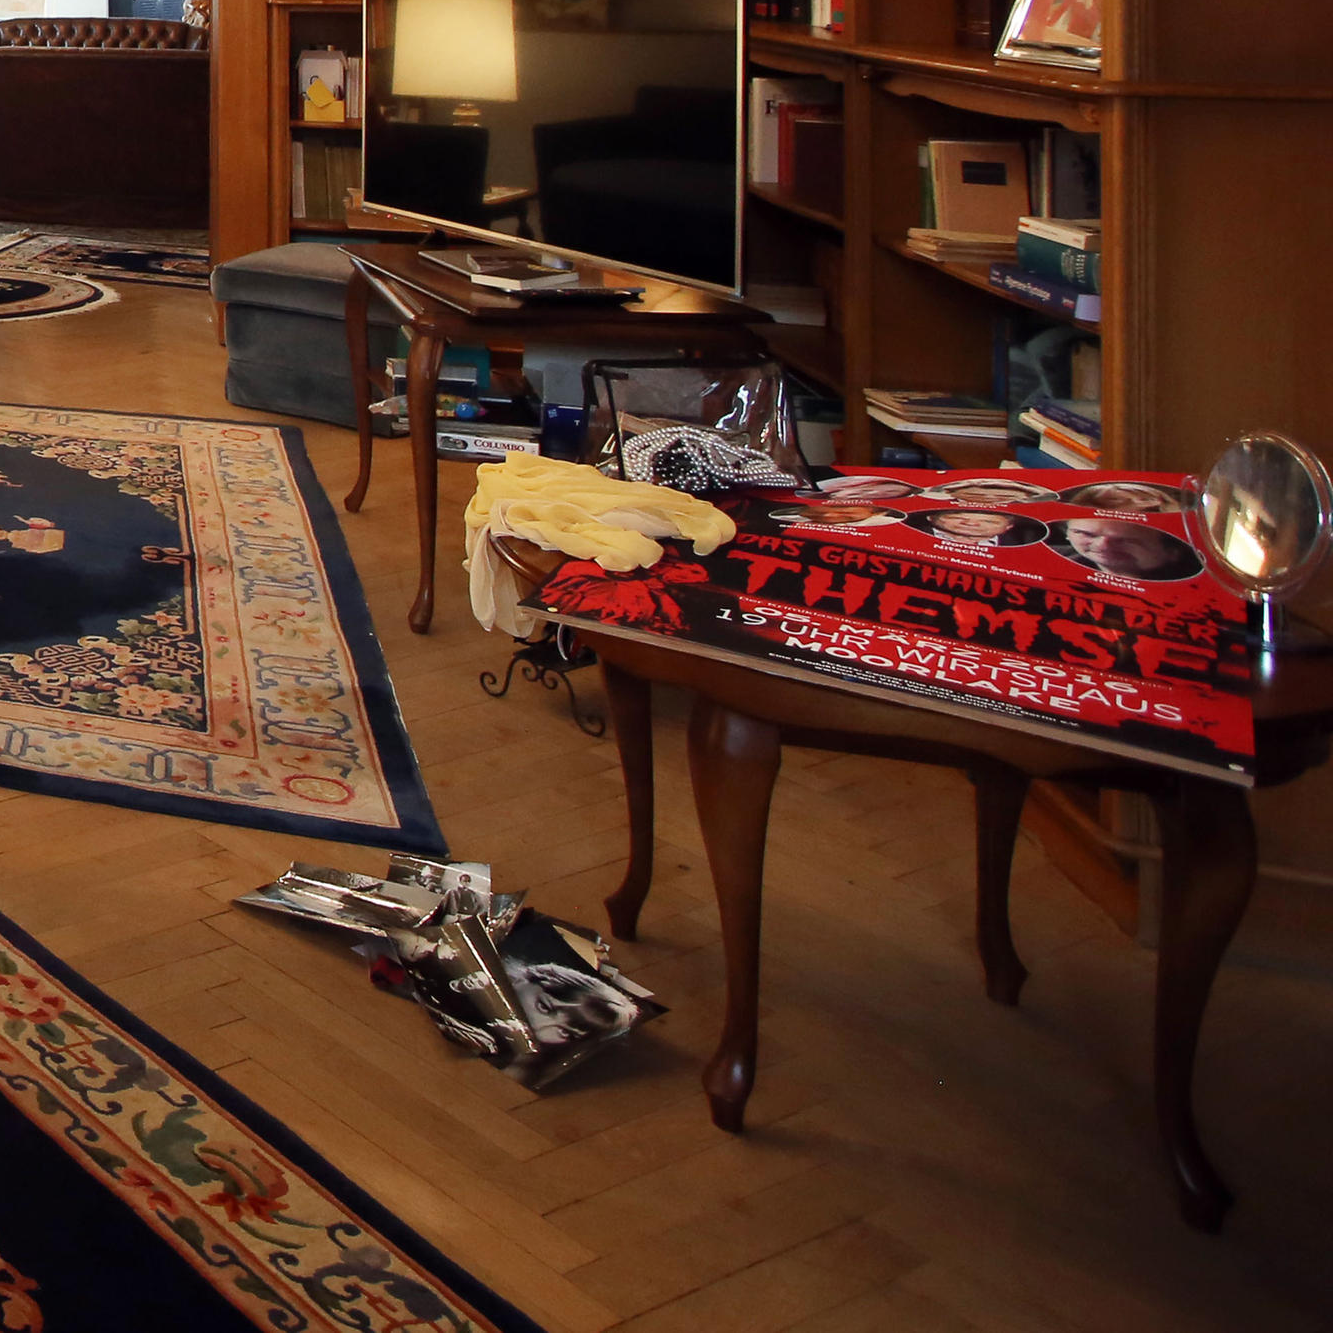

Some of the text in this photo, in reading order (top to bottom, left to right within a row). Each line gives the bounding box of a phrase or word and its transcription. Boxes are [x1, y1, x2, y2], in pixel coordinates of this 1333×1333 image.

[473, 438, 526, 452] COLUMBO
[933, 543, 995, 559] Nitschke
[941, 539, 989, 552] Ronald
[950, 557, 988, 569] Maren
[990, 565, 1044, 581] Seyboldt
[1094, 571, 1140, 585] Oliver
[734, 532, 1220, 646] DAS GASTHAUS AN DER
[1087, 575, 1146, 592] Nitsche
[727, 549, 1218, 690] THEMSE
[753, 606, 822, 627] 05.
[839, 623, 982, 661] MÄRZ
[999, 657, 1139, 694] 2016
[715, 608, 768, 627] 19
[780, 621, 871, 651] UHR
[896, 645, 1183, 721] WIRTSHAUS
[784, 636, 1081, 713] MOORLAKE
